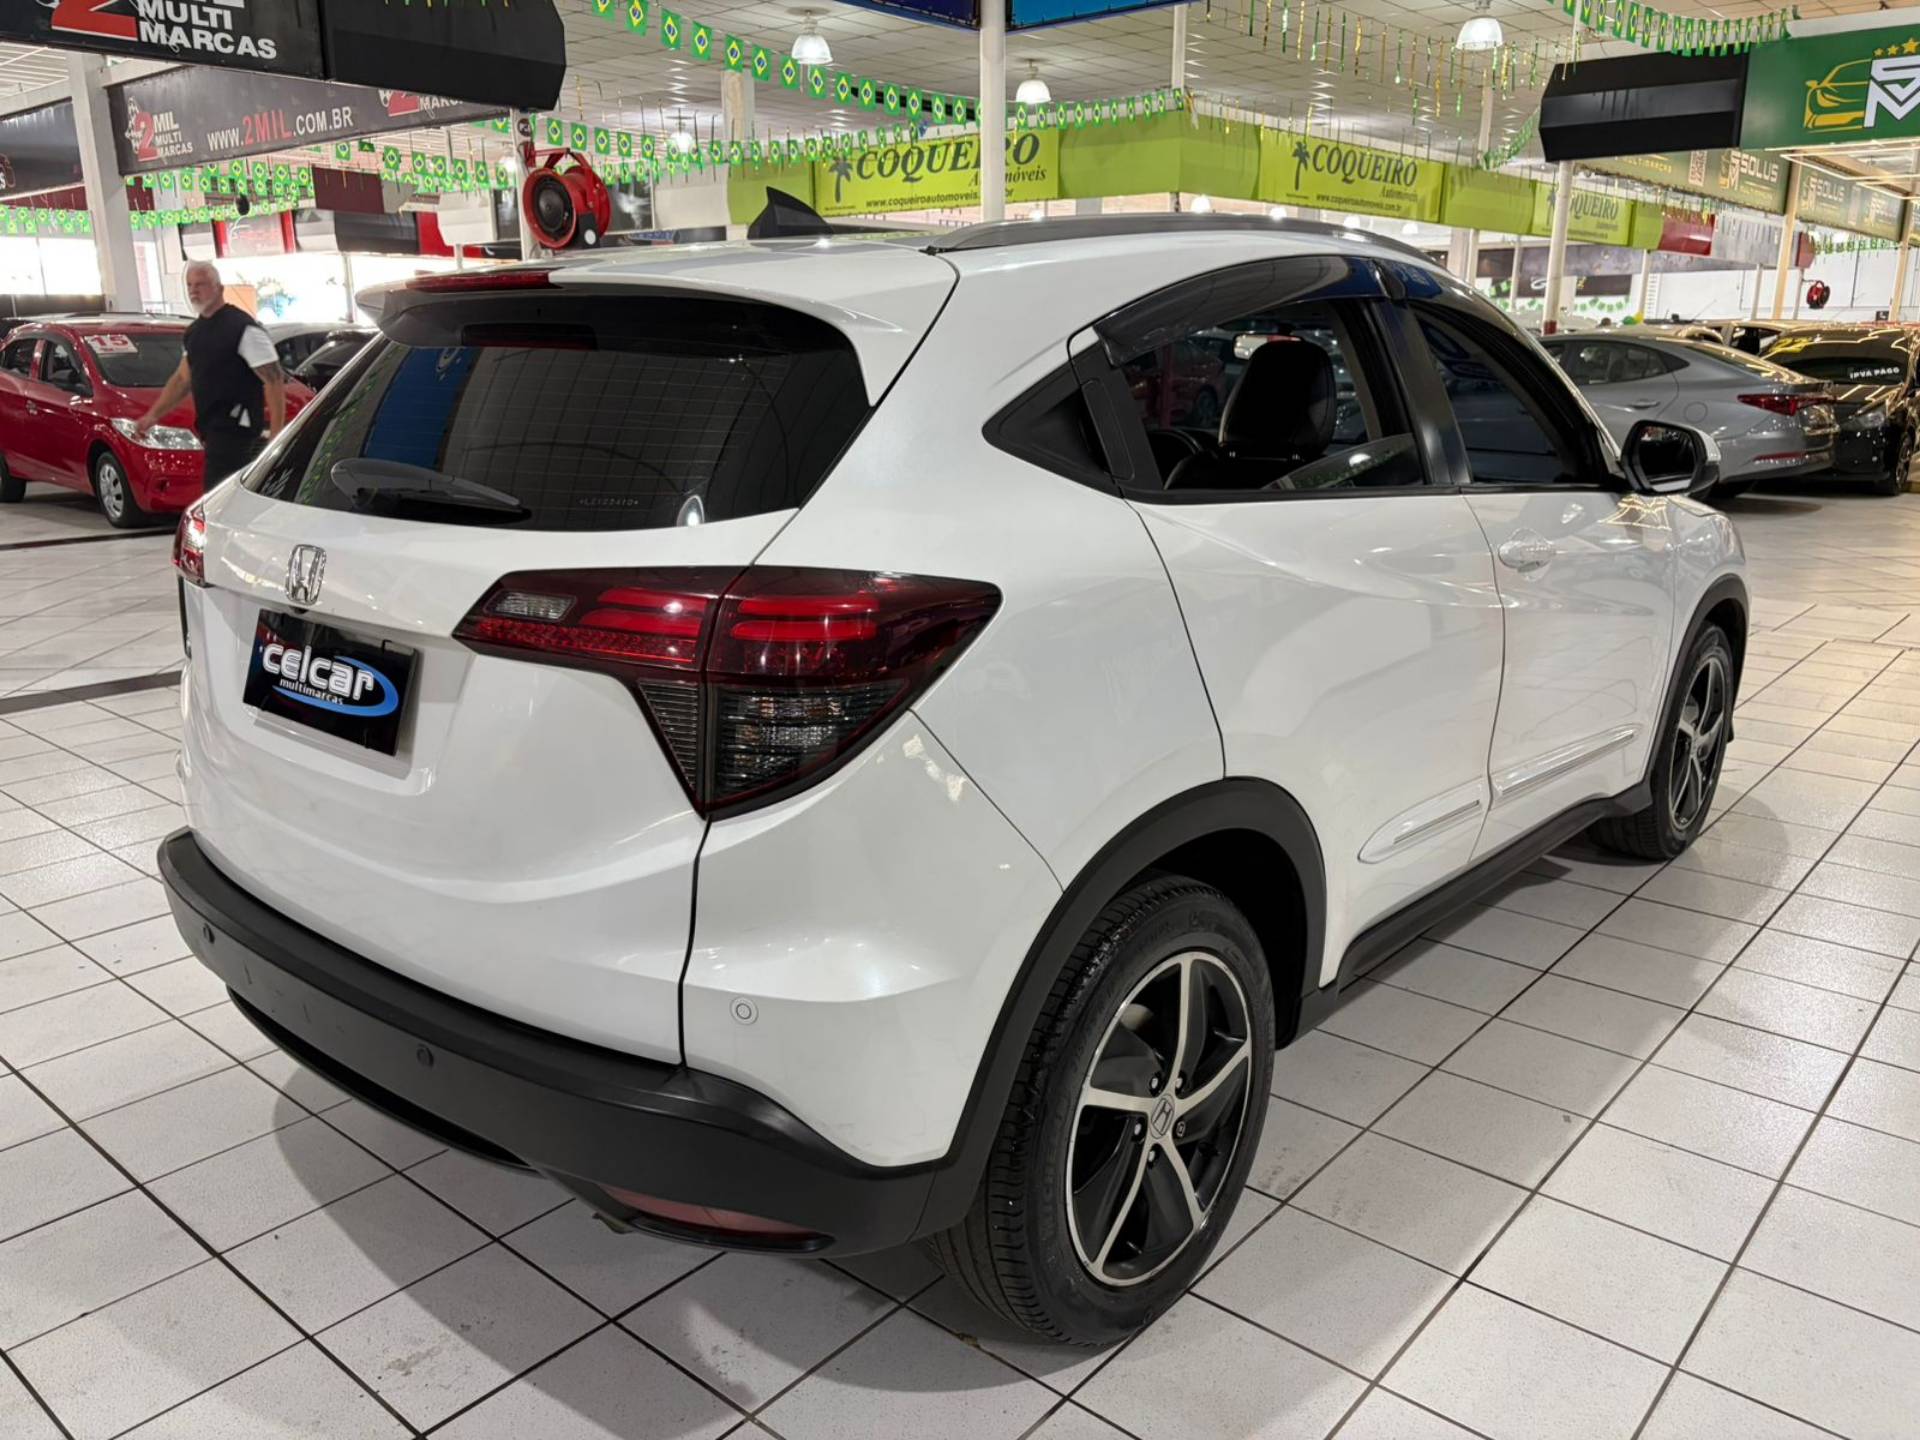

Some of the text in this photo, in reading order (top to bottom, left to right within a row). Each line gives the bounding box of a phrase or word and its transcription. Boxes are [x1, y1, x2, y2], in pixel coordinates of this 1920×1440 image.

[136, 0, 233, 30] MULTI
[138, 20, 277, 59] MARCAS
[153, 111, 180, 133] MIL
[206, 106, 354, 152] WWW.2MIL.COM.BR
[156, 130, 182, 145] MULTI
[856, 132, 1040, 182] COQUEO
[1312, 143, 1418, 187] COQUEIRO
[1740, 152, 1779, 184] SOLUS
[1569, 191, 1619, 220] QUEIRO
[91, 335, 129, 347] 15
[1849, 370, 1873, 379] IPVA
[262, 643, 374, 700] celcar
[279, 677, 344, 706] multimarcas
